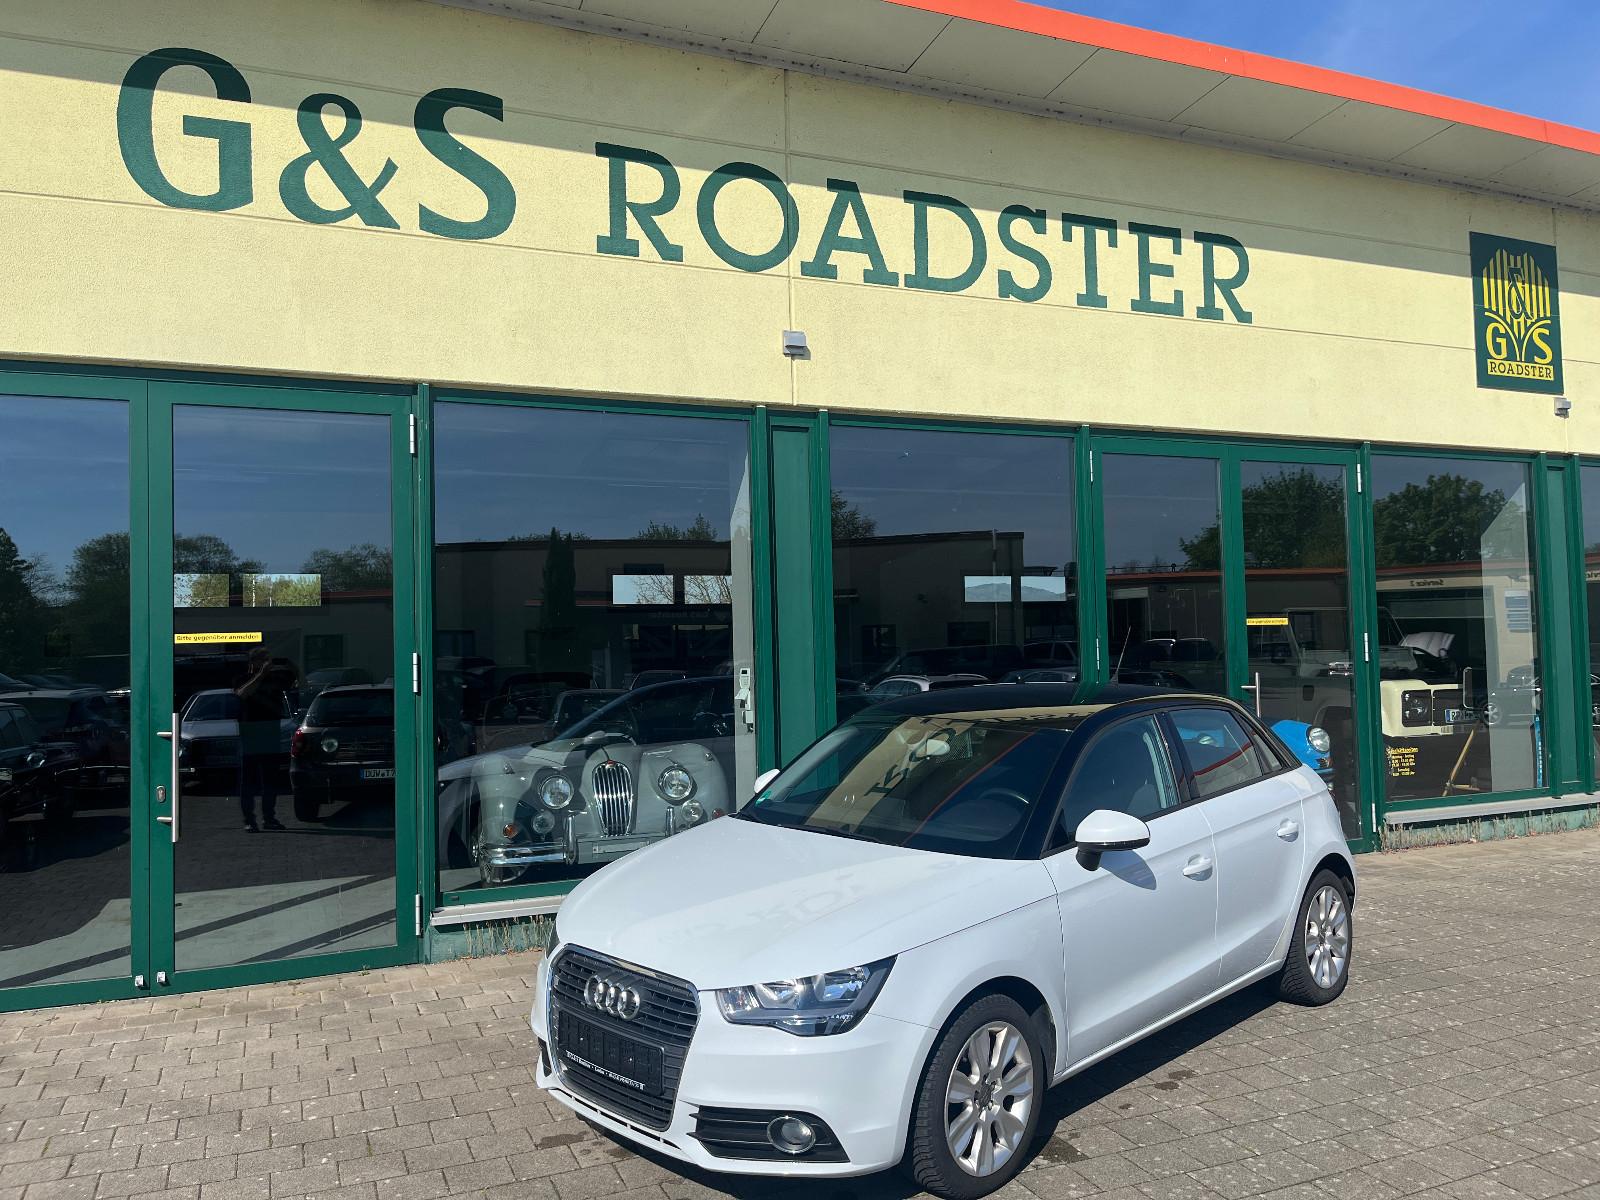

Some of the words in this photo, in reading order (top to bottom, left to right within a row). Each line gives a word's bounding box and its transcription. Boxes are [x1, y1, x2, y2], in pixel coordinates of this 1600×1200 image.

[117, 47, 518, 241] G&S
[595, 141, 1253, 325] ROADSTER
[1486, 322, 1508, 360] G
[1532, 327, 1553, 365] S
[1489, 361, 1553, 379] ROADSTER
